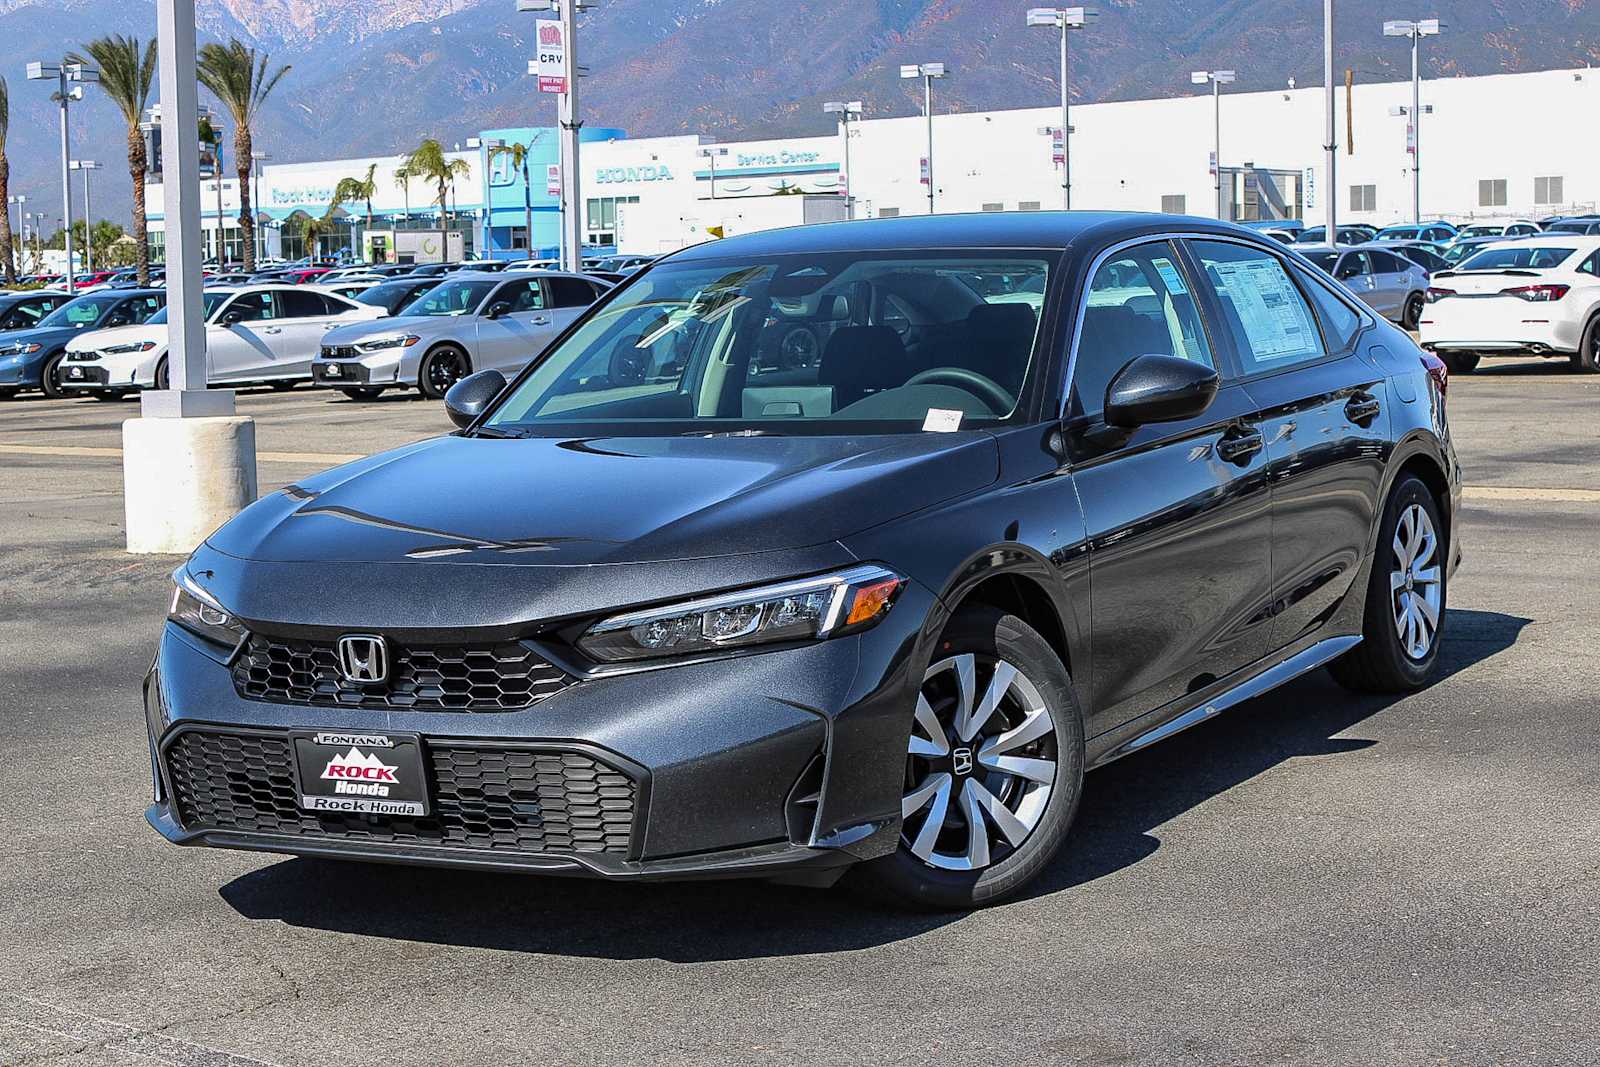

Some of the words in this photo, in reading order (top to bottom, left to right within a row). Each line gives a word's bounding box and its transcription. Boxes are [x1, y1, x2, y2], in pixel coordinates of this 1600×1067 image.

[540, 54, 562, 64] CRV
[737, 153, 777, 167] Service
[781, 149, 820, 163] Center
[596, 165, 674, 184] HONDA
[322, 736, 386, 746] FONTANA
[328, 765, 393, 780] ROCK
[335, 781, 389, 796] Honda
[314, 799, 365, 811] Rock
[371, 802, 415, 814] Honda
